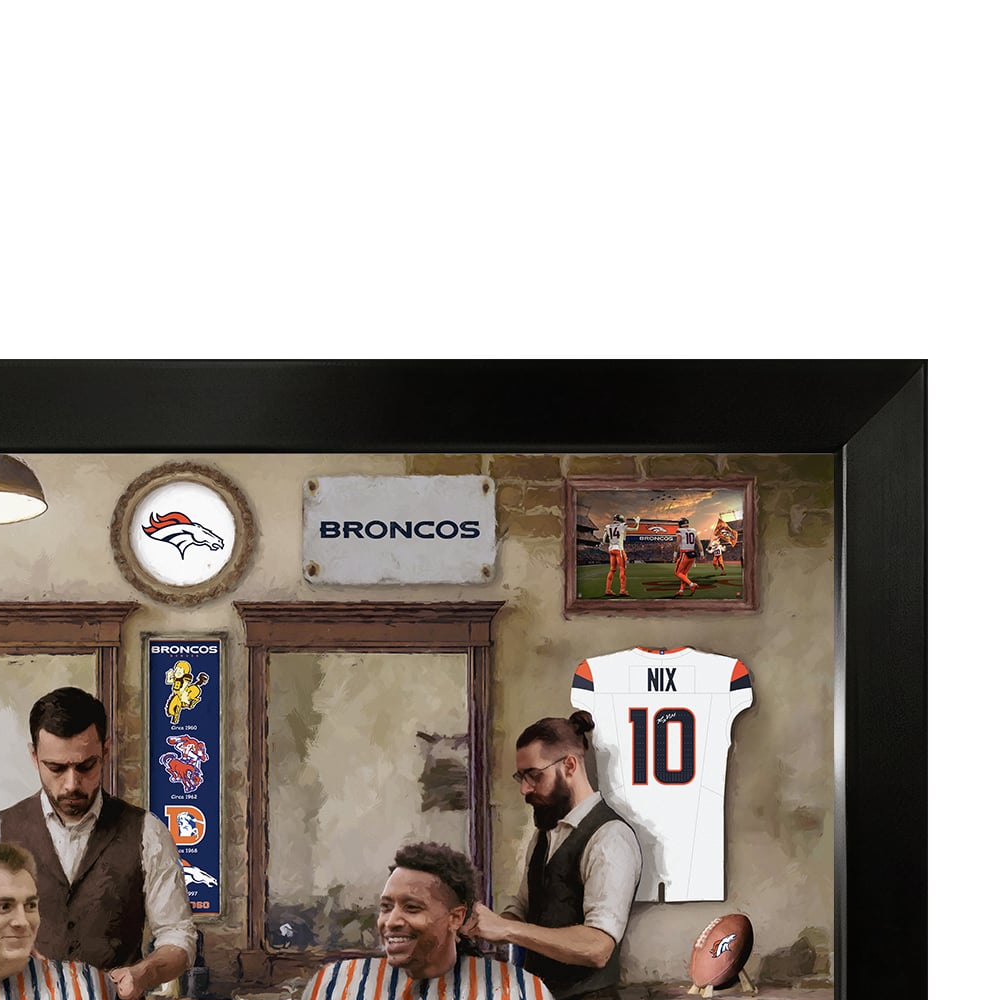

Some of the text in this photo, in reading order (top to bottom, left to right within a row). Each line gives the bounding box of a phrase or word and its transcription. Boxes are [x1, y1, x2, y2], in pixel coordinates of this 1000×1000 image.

[319, 520, 481, 540] BRONCOS
[609, 527, 620, 539] 14
[685, 532, 695, 545] 10
[151, 645, 218, 654] BRONCOS
[647, 668, 677, 692] NIX
[628, 707, 696, 786] 10
[190, 901, 210, 909] 960
